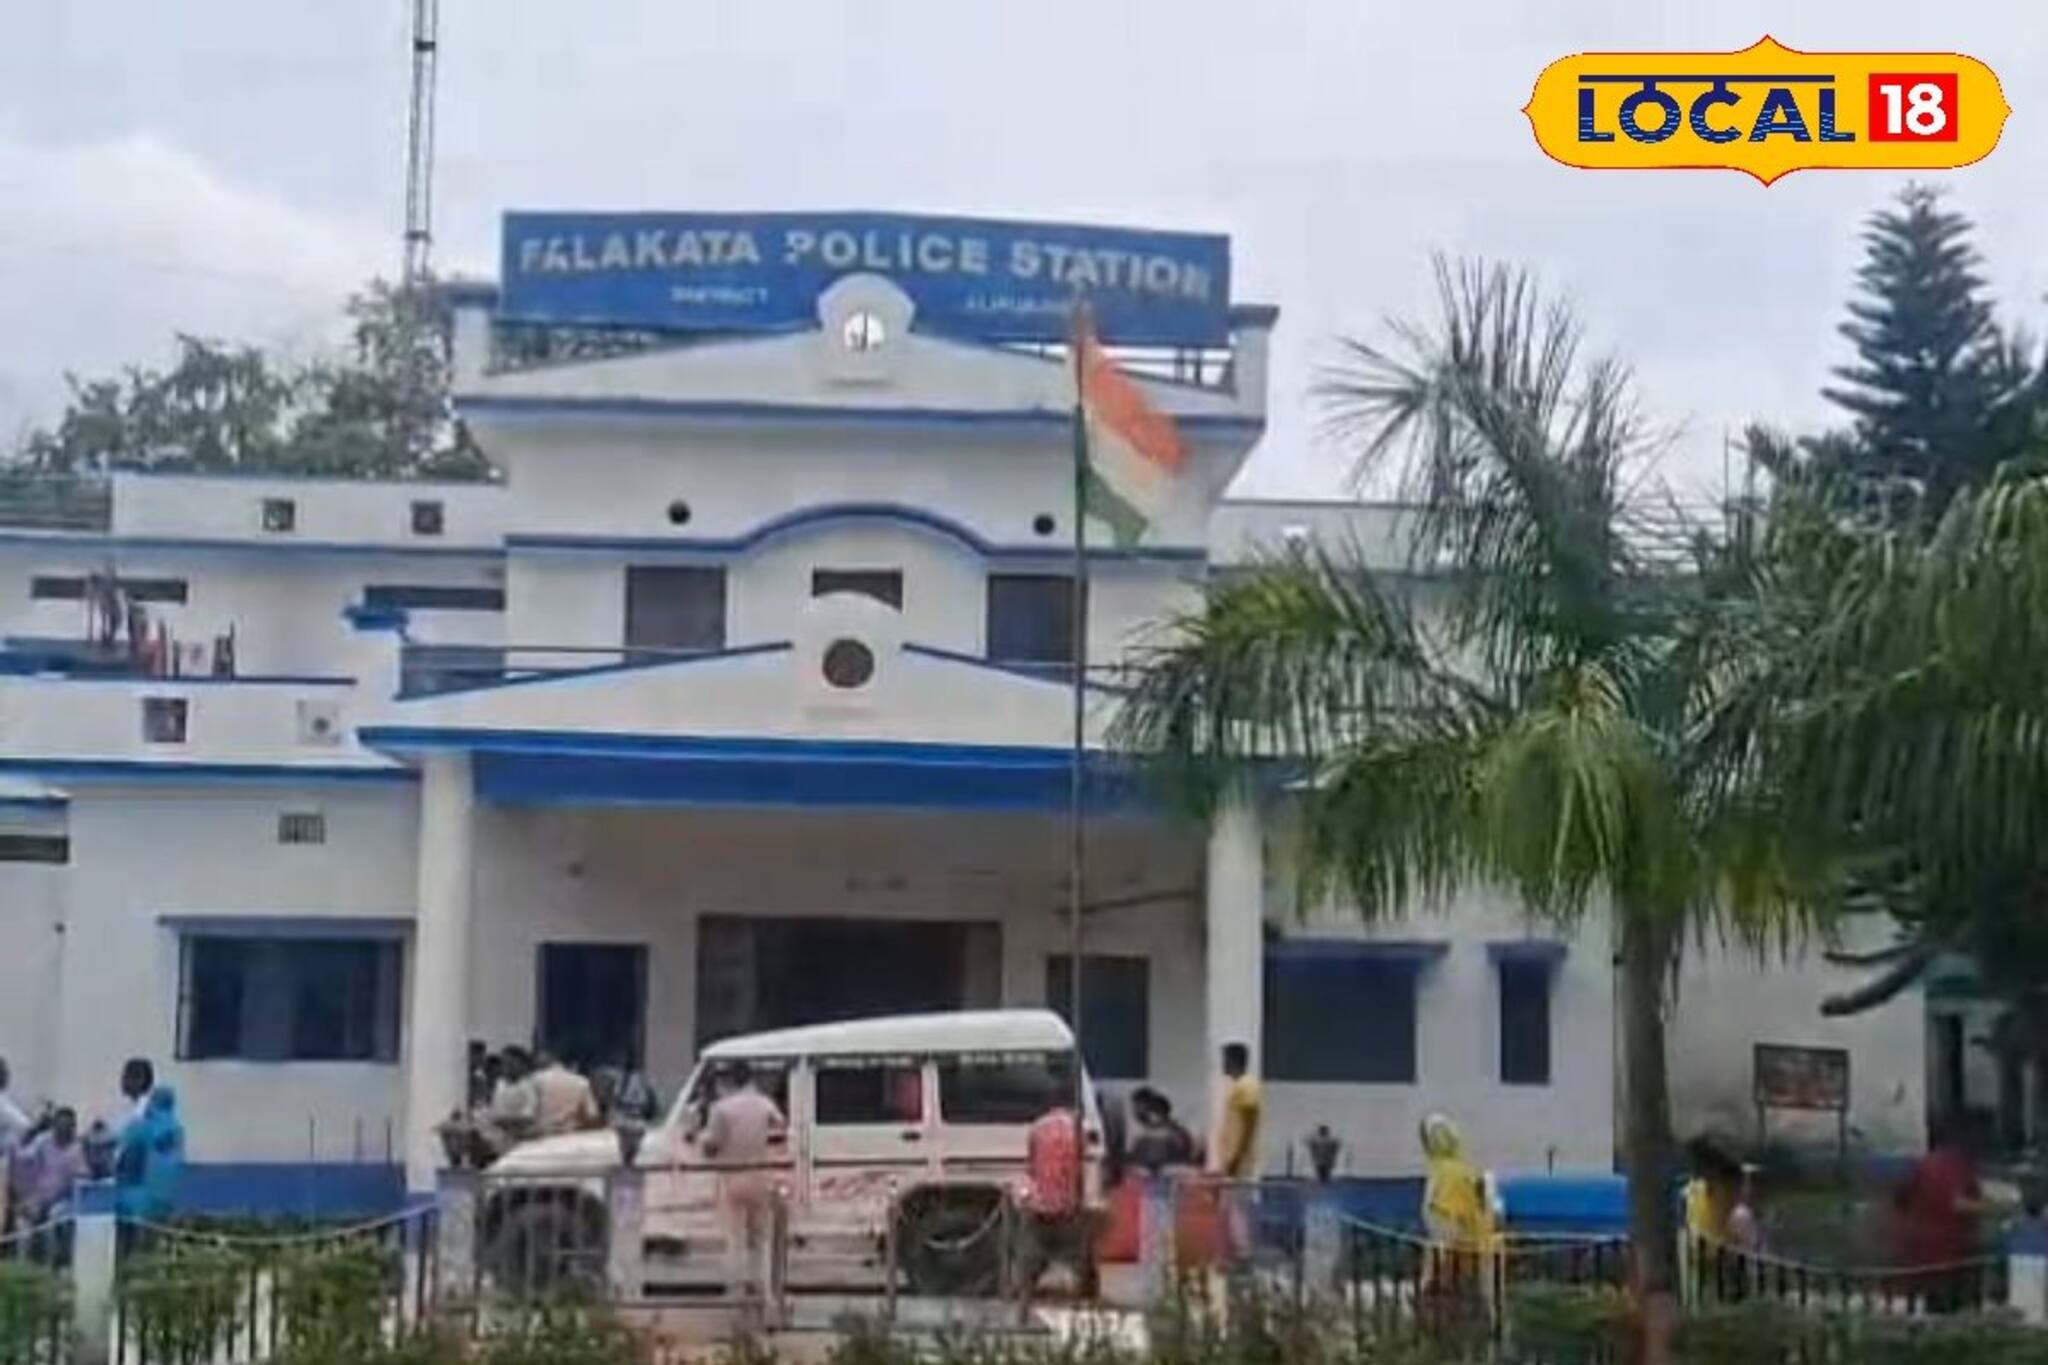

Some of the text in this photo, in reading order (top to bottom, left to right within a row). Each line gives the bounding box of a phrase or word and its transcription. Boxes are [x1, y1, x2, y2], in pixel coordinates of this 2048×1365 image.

[520, 229, 1211, 298] FALAKATA POLICE STATION
